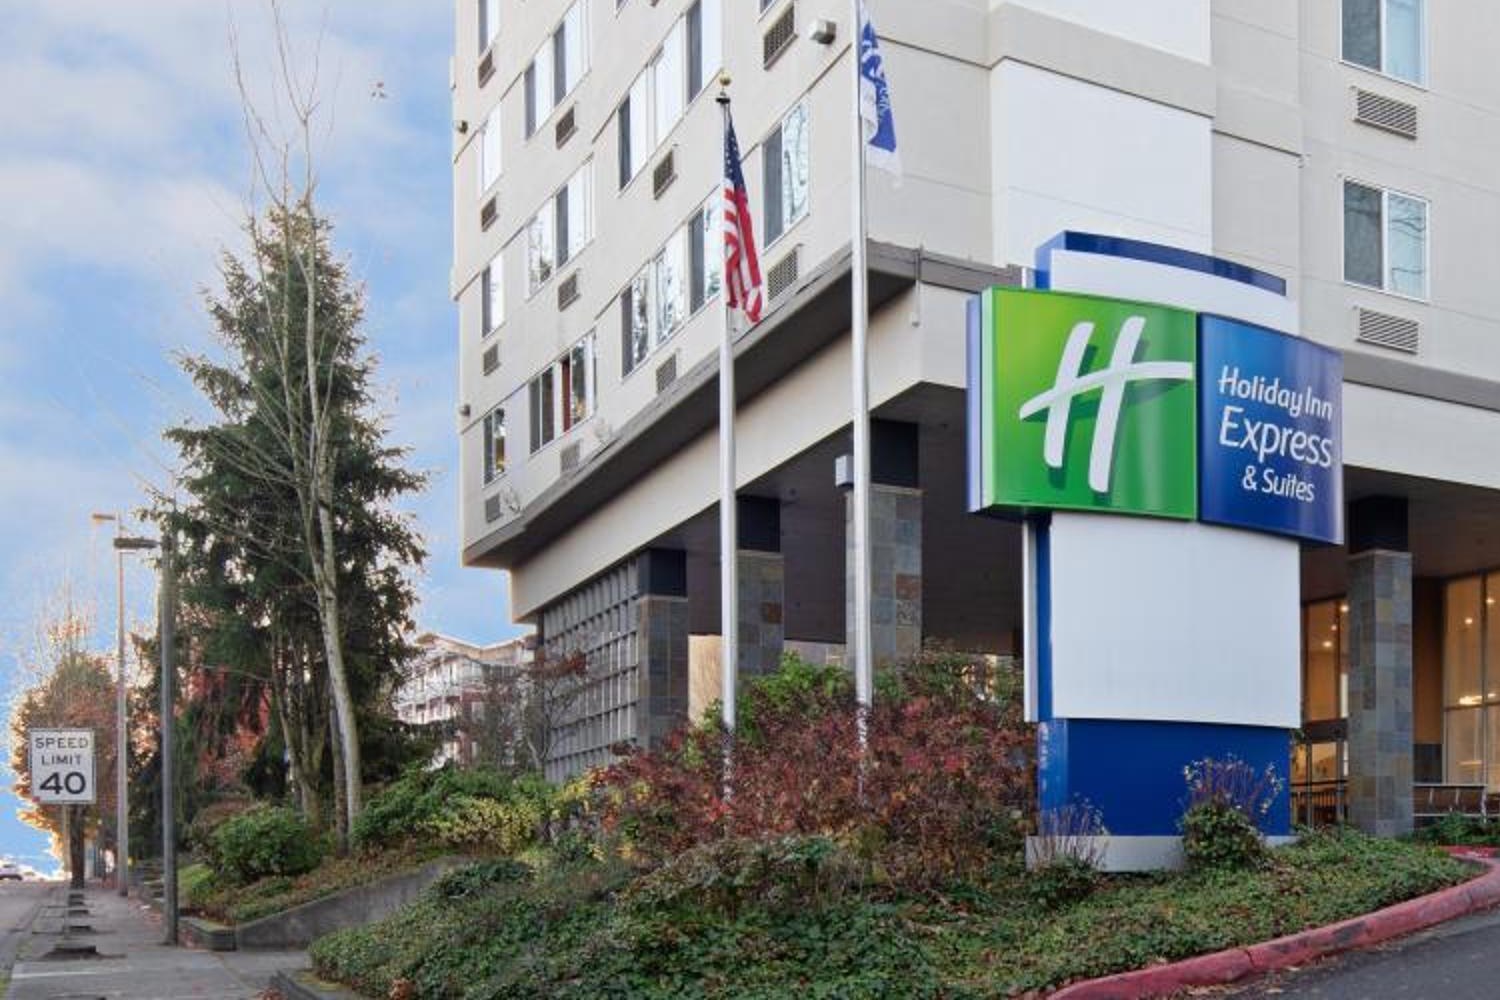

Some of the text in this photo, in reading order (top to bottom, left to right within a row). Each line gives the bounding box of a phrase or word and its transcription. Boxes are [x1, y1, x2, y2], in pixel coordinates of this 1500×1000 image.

[1218, 365, 1333, 421] Holiday Inn
[1219, 404, 1333, 468] Express
[1242, 465, 1315, 503] & Suites
[35, 737, 89, 749] SPEED
[41, 754, 82, 766] LIMIT
[39, 771, 87, 795] 40
